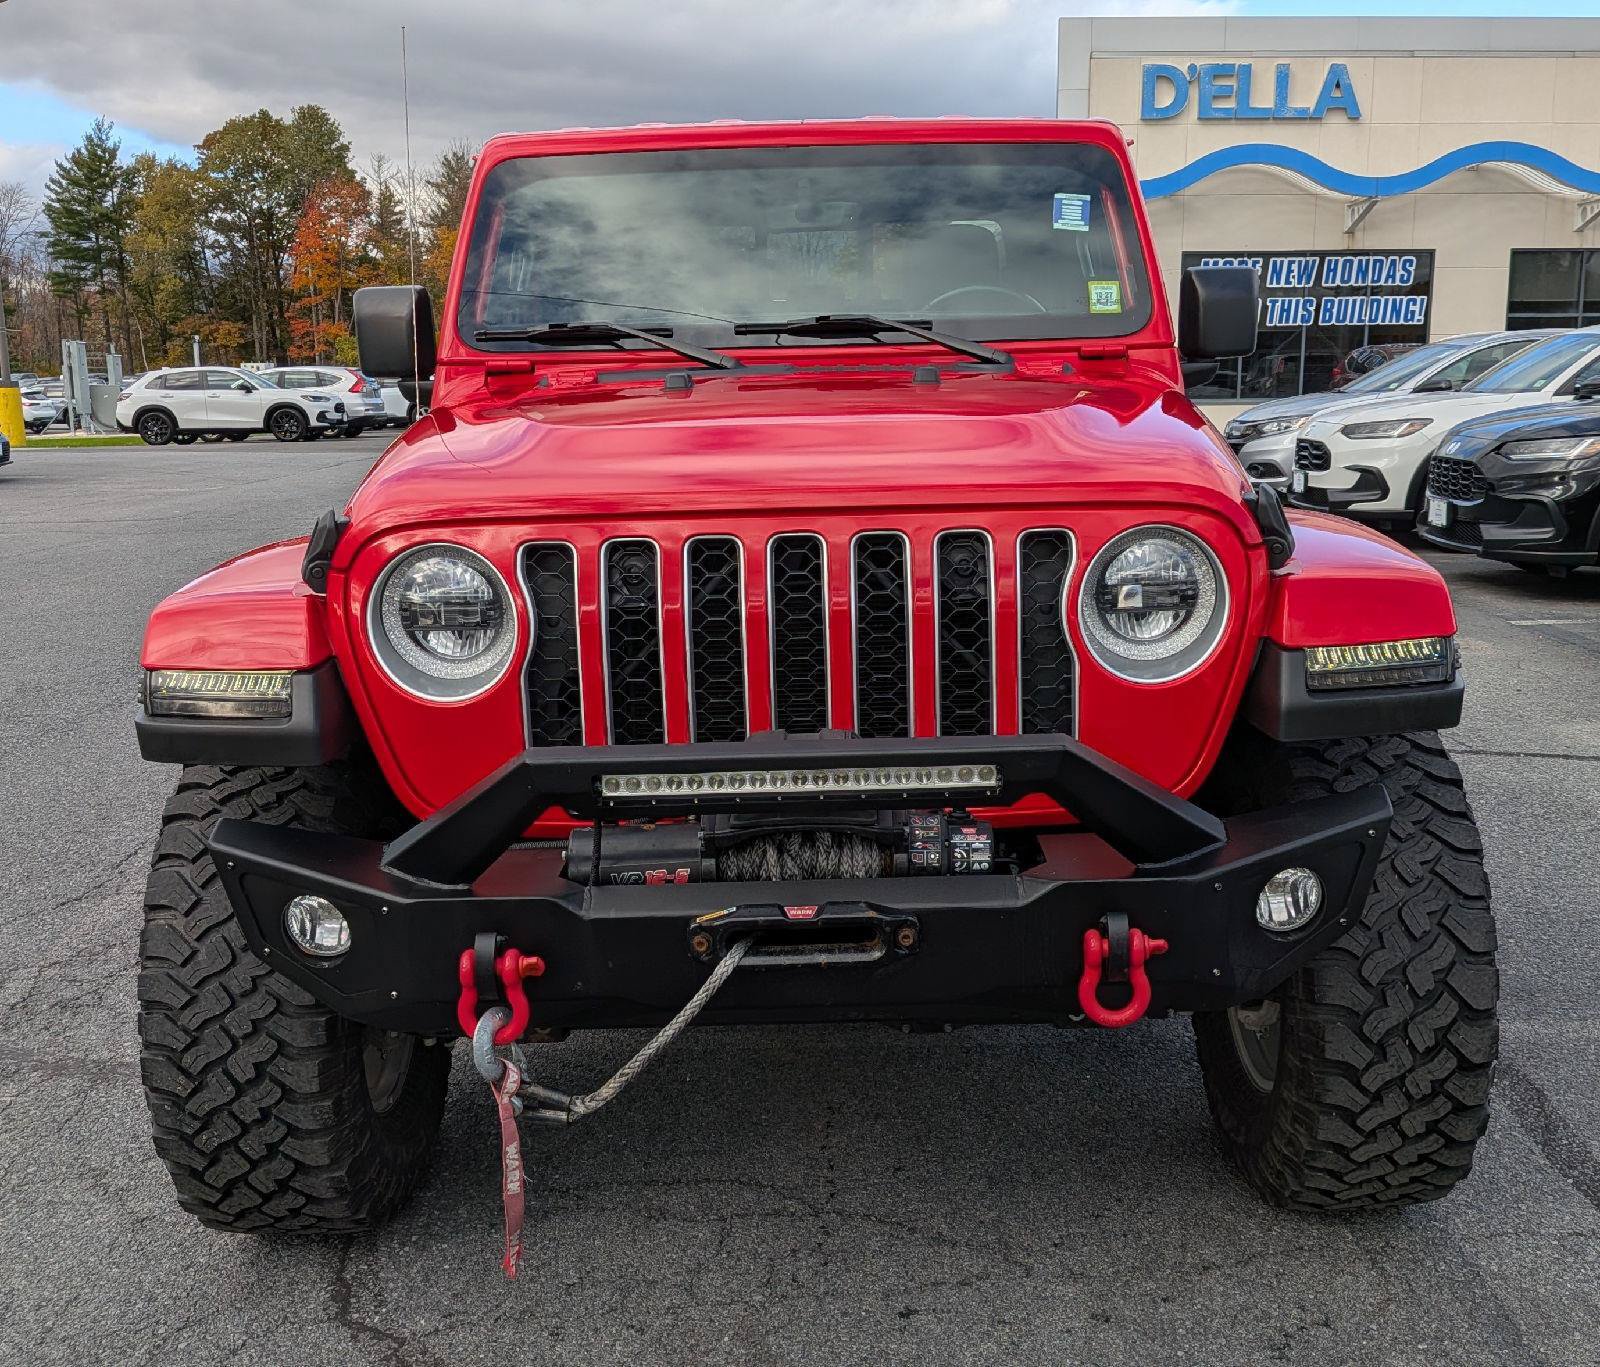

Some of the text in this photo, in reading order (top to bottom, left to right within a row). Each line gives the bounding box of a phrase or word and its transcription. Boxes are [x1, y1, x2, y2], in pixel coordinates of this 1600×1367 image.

[1140, 63, 1361, 120] D'ELLA
[1266, 257, 1319, 287] NEW
[1322, 256, 1416, 287] HONDAS
[1266, 296, 1427, 326] THIS BUILDING!
